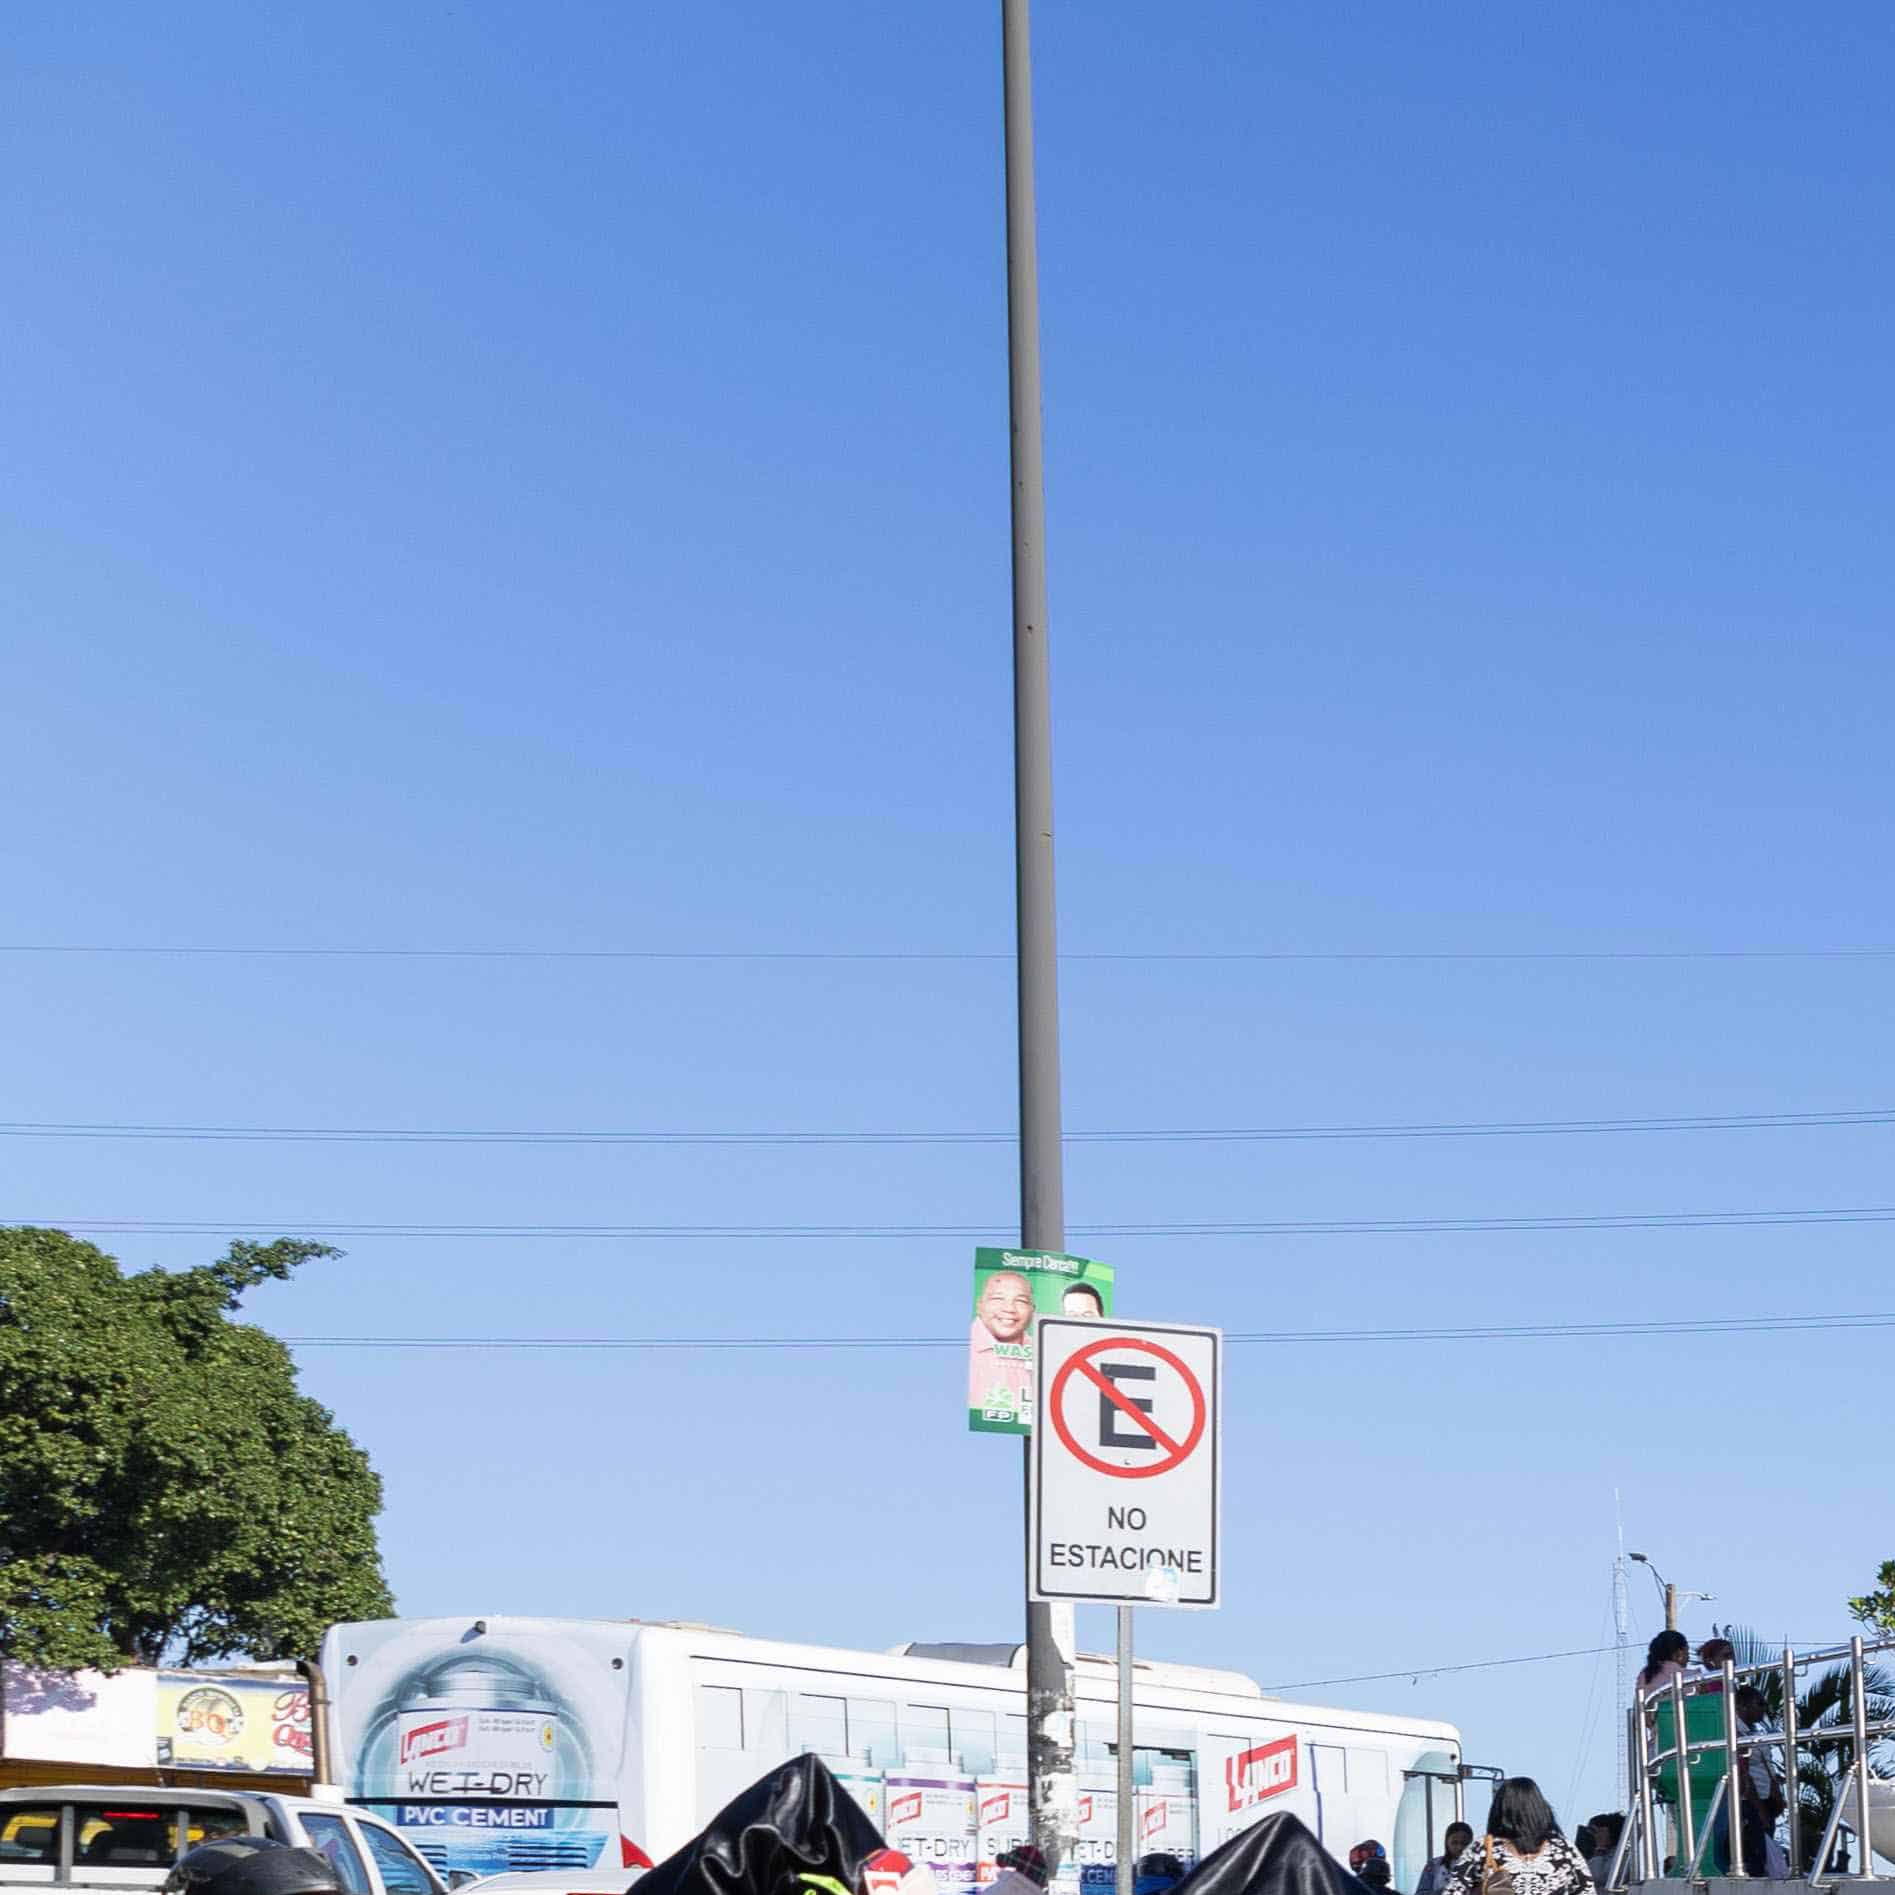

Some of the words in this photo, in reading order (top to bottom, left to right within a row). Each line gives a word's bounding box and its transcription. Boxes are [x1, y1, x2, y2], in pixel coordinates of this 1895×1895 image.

[1099, 1362, 1157, 1451] E
[1107, 1505, 1147, 1532] NO
[1049, 1542, 1203, 1574] ESTACIONE
[408, 1771, 549, 1795] WET-DRY
[404, 1807, 446, 1825] PVC
[451, 1807, 548, 1827] CEMENT
